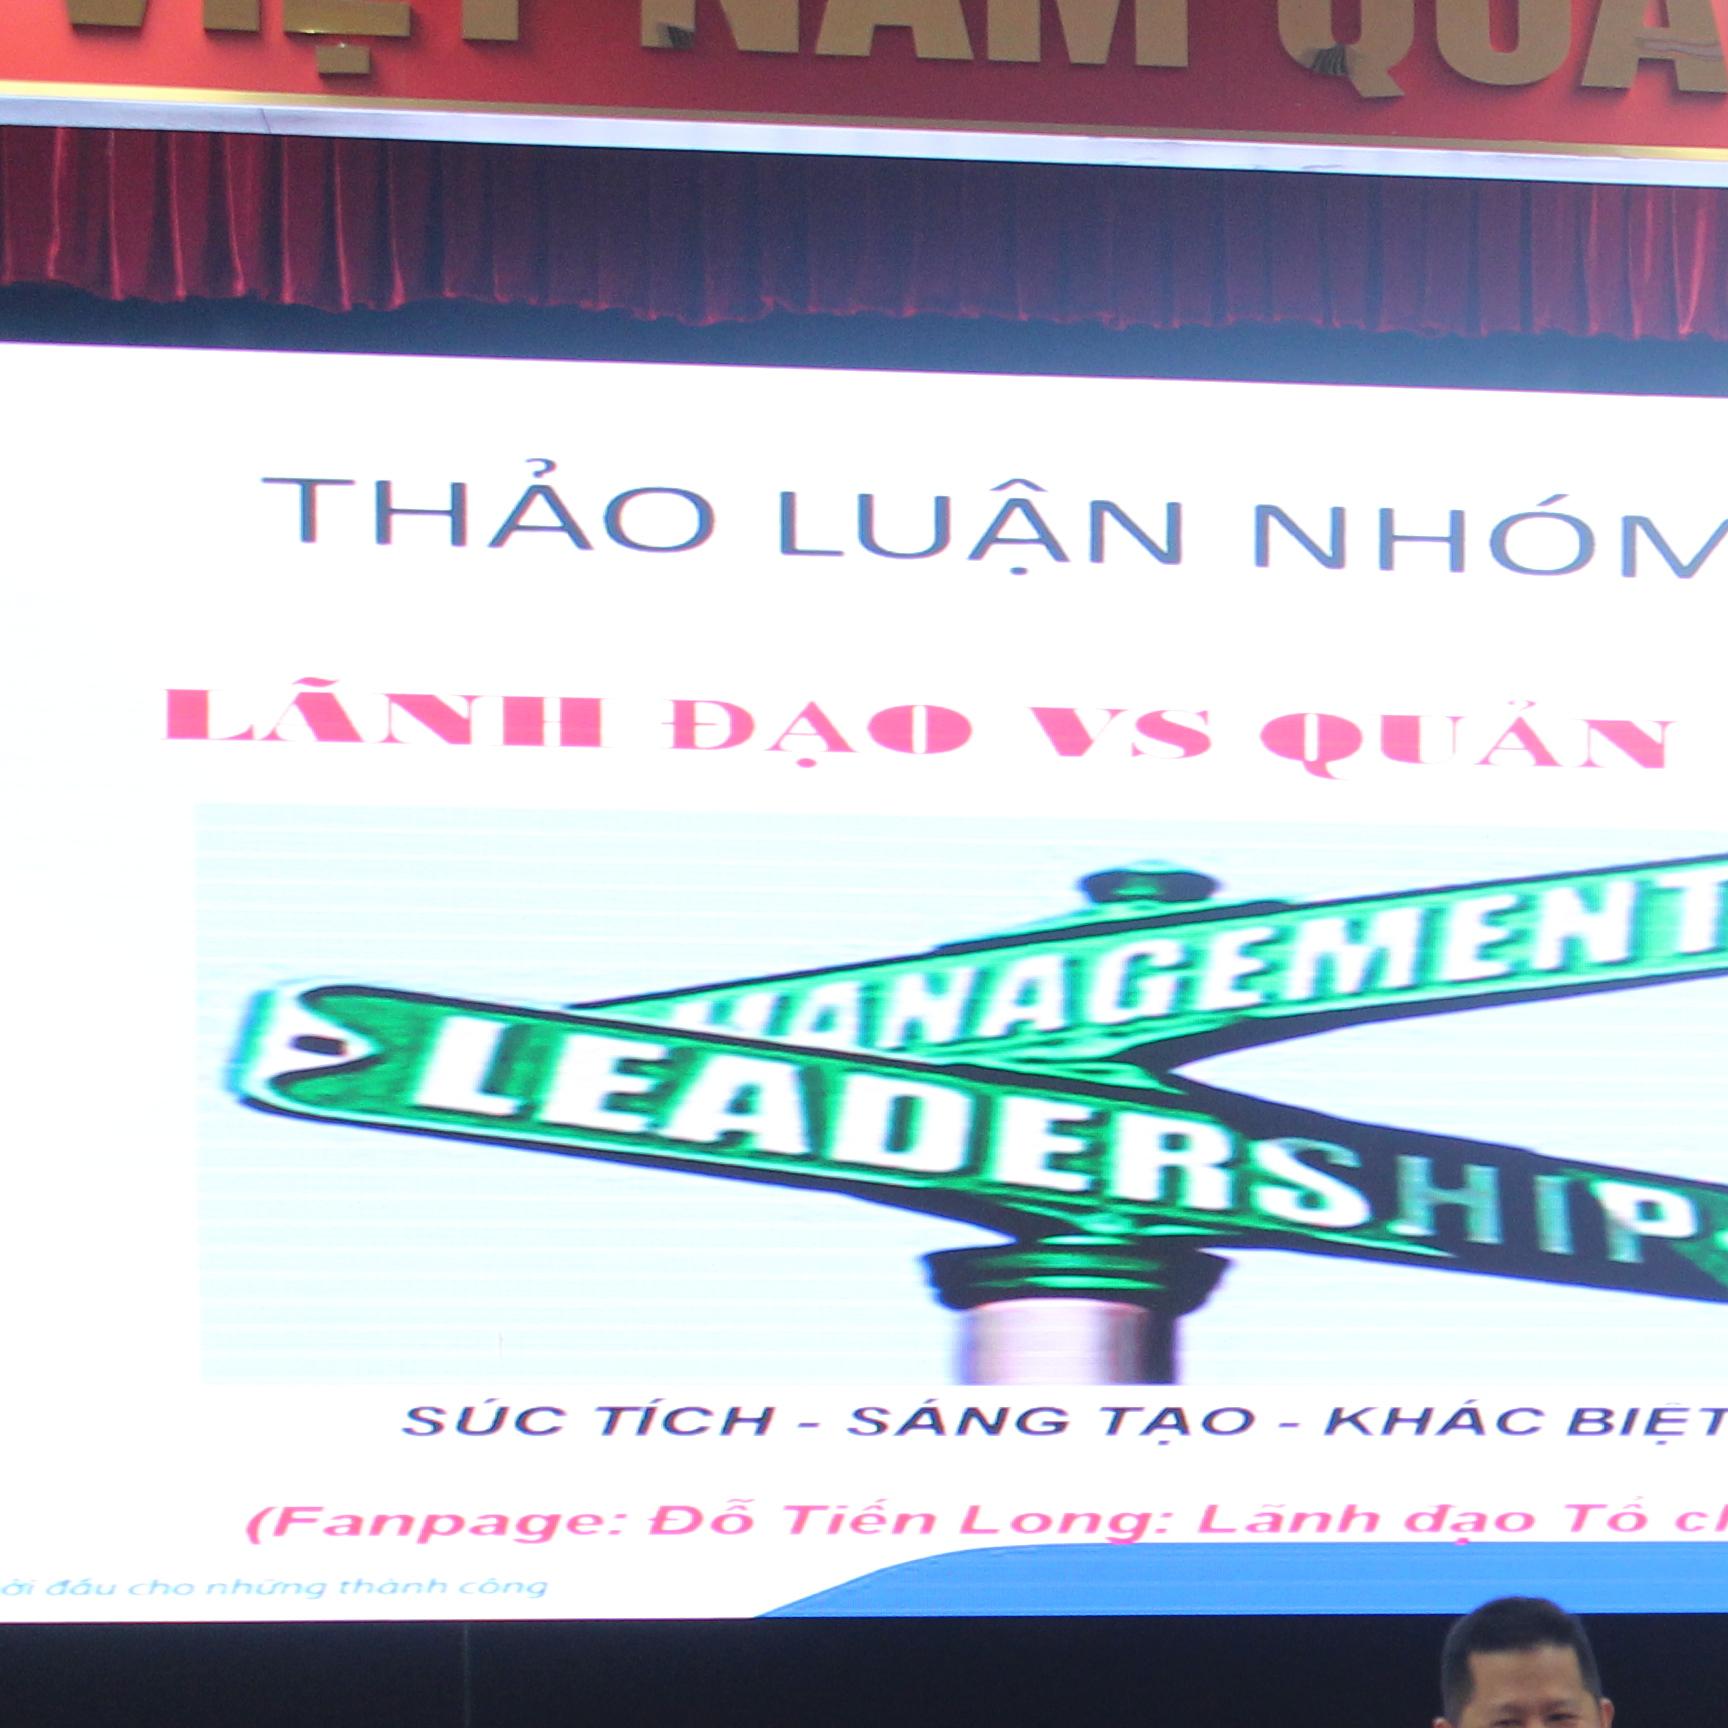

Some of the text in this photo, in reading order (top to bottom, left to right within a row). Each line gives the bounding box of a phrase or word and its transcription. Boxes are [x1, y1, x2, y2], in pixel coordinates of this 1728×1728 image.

[260, 456, 716, 553] THẢO
[779, 477, 1182, 576] LUẬN
[165, 676, 603, 748] LÃNH
[666, 698, 974, 769] ĐẠO
[1030, 706, 1212, 758] VS
[1260, 700, 1672, 780] QUẢN
[410, 1010, 1698, 1266] LEADERSHIP
[402, 1398, 567, 1437] SÚC
[595, 1398, 776, 1437] TÍCH
[847, 1398, 1069, 1437] SÁNG
[1100, 1405, 1256, 1446] TẠO
[1324, 1399, 1545, 1436] KHÁC
[245, 1505, 628, 1545] (Fanpage:
[648, 1498, 754, 1536] Đỗ
[783, 1498, 937, 1535] Tiến
[960, 1504, 1173, 1545] Long:
[1198, 1503, 1381, 1534] Lãnh
[1404, 1503, 1535, 1545] đạo
[1565, 1496, 1648, 1533] Tổ
[127, 1578, 196, 1597] cho
